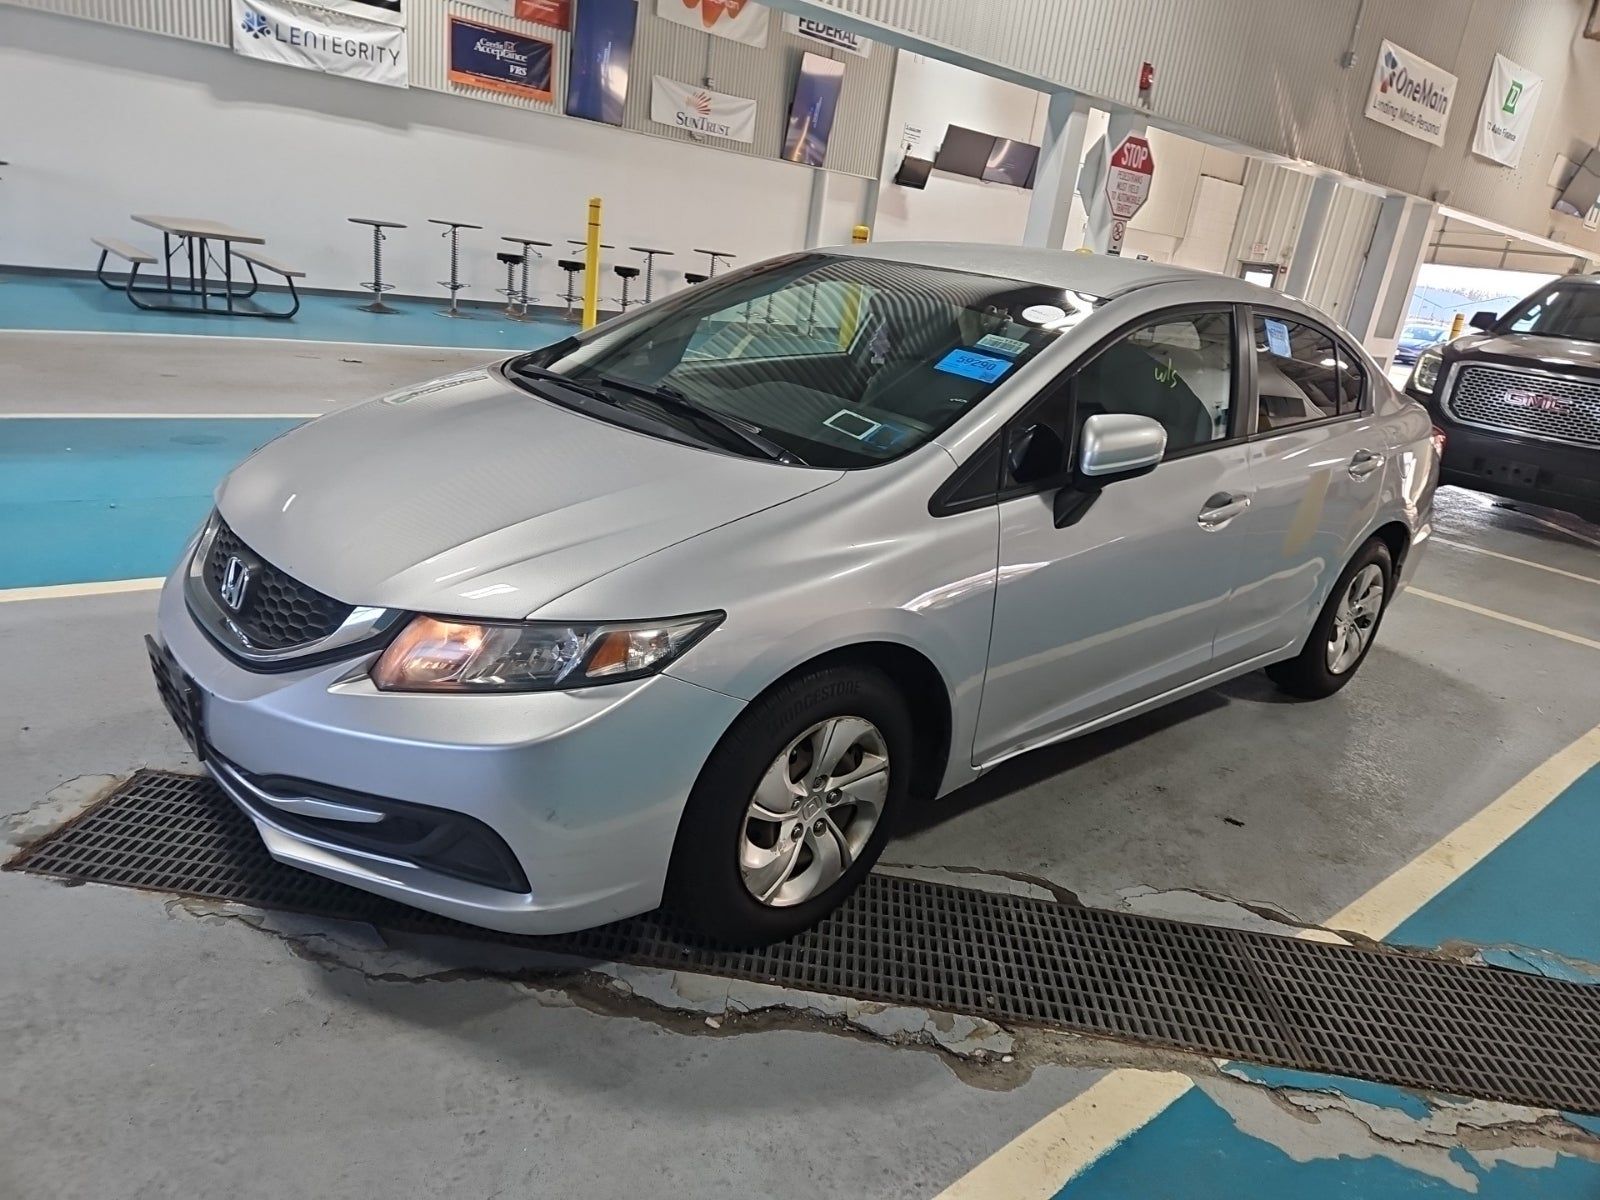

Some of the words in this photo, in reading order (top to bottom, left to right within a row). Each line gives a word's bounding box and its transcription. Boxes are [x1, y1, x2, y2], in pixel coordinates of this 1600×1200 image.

[275, 24, 400, 66] LENTEGRITY
[799, 17, 858, 46] FEDERAL
[473, 41, 528, 63] Acceptance
[1396, 66, 1448, 115] OneMain
[1121, 142, 1149, 169] STOP
[956, 355, 997, 371] 59290
[1504, 390, 1570, 415] GMC
